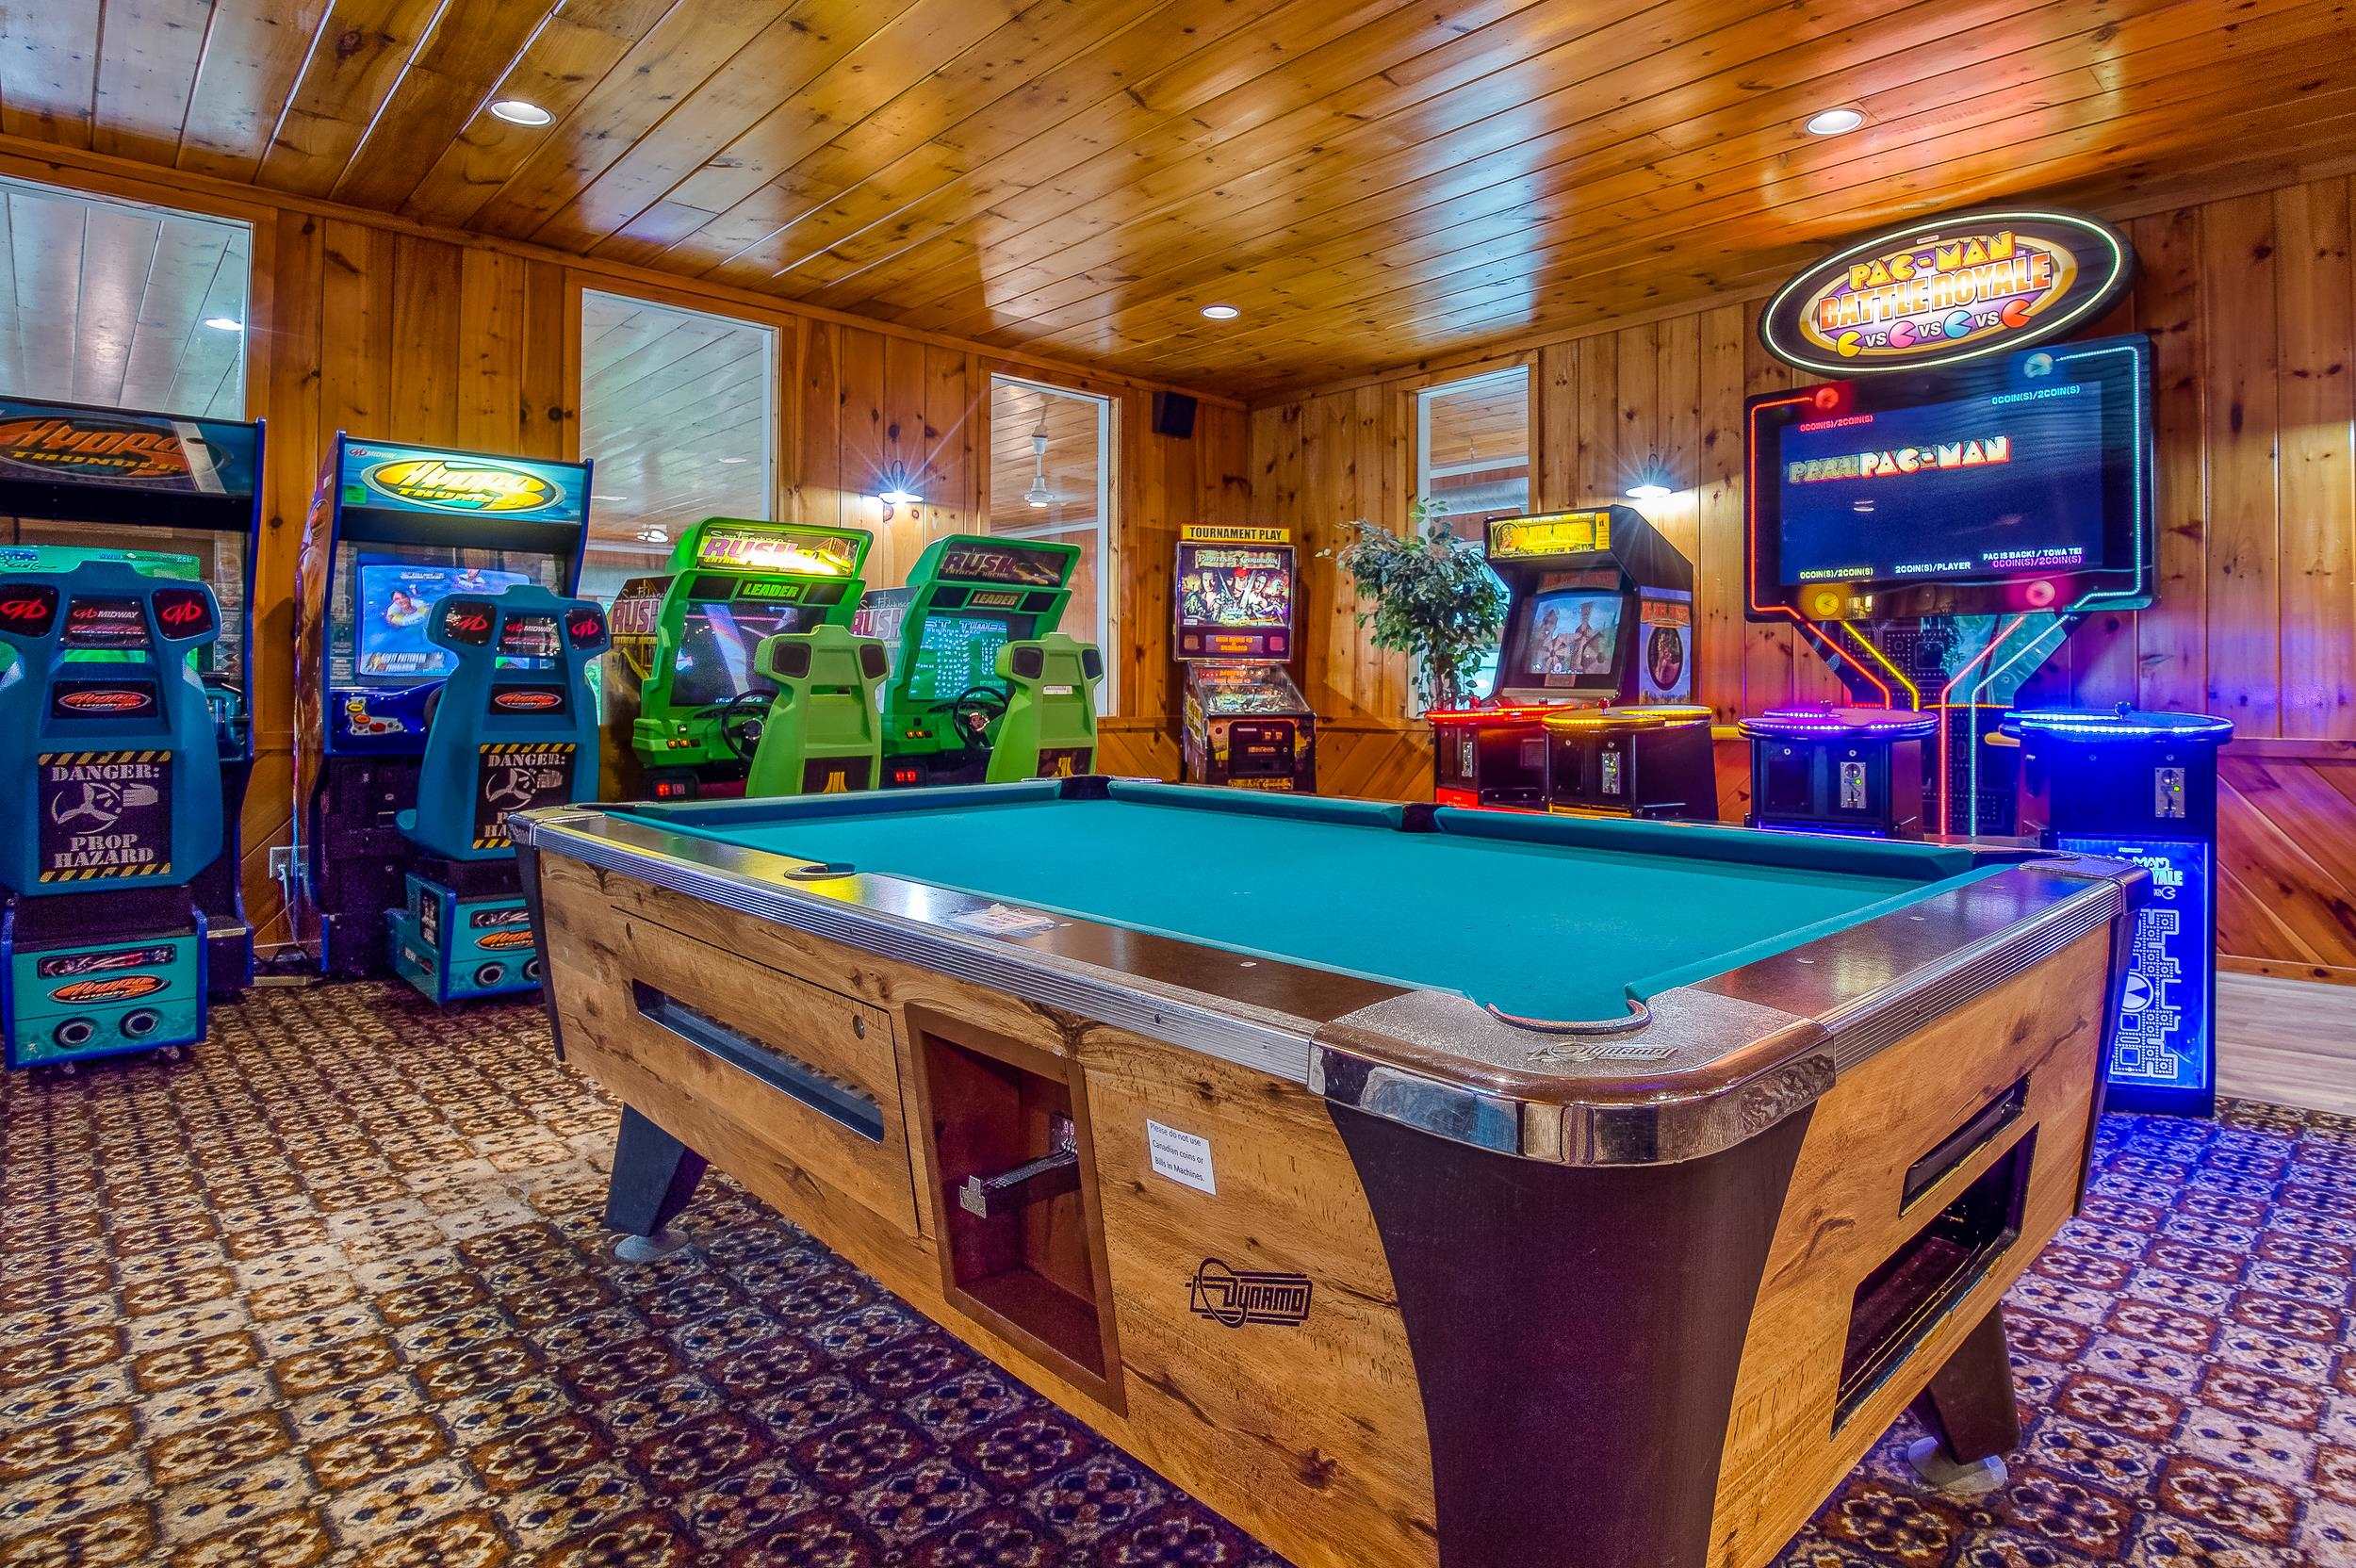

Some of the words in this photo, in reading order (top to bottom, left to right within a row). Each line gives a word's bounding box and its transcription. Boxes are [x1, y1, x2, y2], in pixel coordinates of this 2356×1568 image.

[1848, 230, 2016, 291] PAC-MAN
[1819, 276, 1930, 332] BATTLE
[1931, 250, 2053, 312] ROYALE
[1864, 333, 1888, 348] VS
[1917, 322, 1942, 337] VS
[1974, 311, 2000, 328] VS
[1859, 435, 2011, 479] PAC-MAN
[1189, 527, 1256, 540] TOURNAMENT
[1259, 530, 1282, 540] PLAY
[942, 551, 1018, 572] RUSH
[743, 583, 799, 597] LEADER
[972, 594, 1018, 605] LEADER
[488, 754, 565, 767] DANGER:
[51, 764, 160, 781] DANGER:
[70, 834, 138, 852] PROP
[54, 847, 155, 868] HAZARD
[1150, 1122, 1169, 1136] Please
[1168, 1130, 1178, 1139] do
[1189, 1136, 1202, 1147] use
[1153, 1139, 1179, 1157] Canadian
[1179, 1150, 1196, 1162] coins
[1173, 1163, 1205, 1183] Machines.
